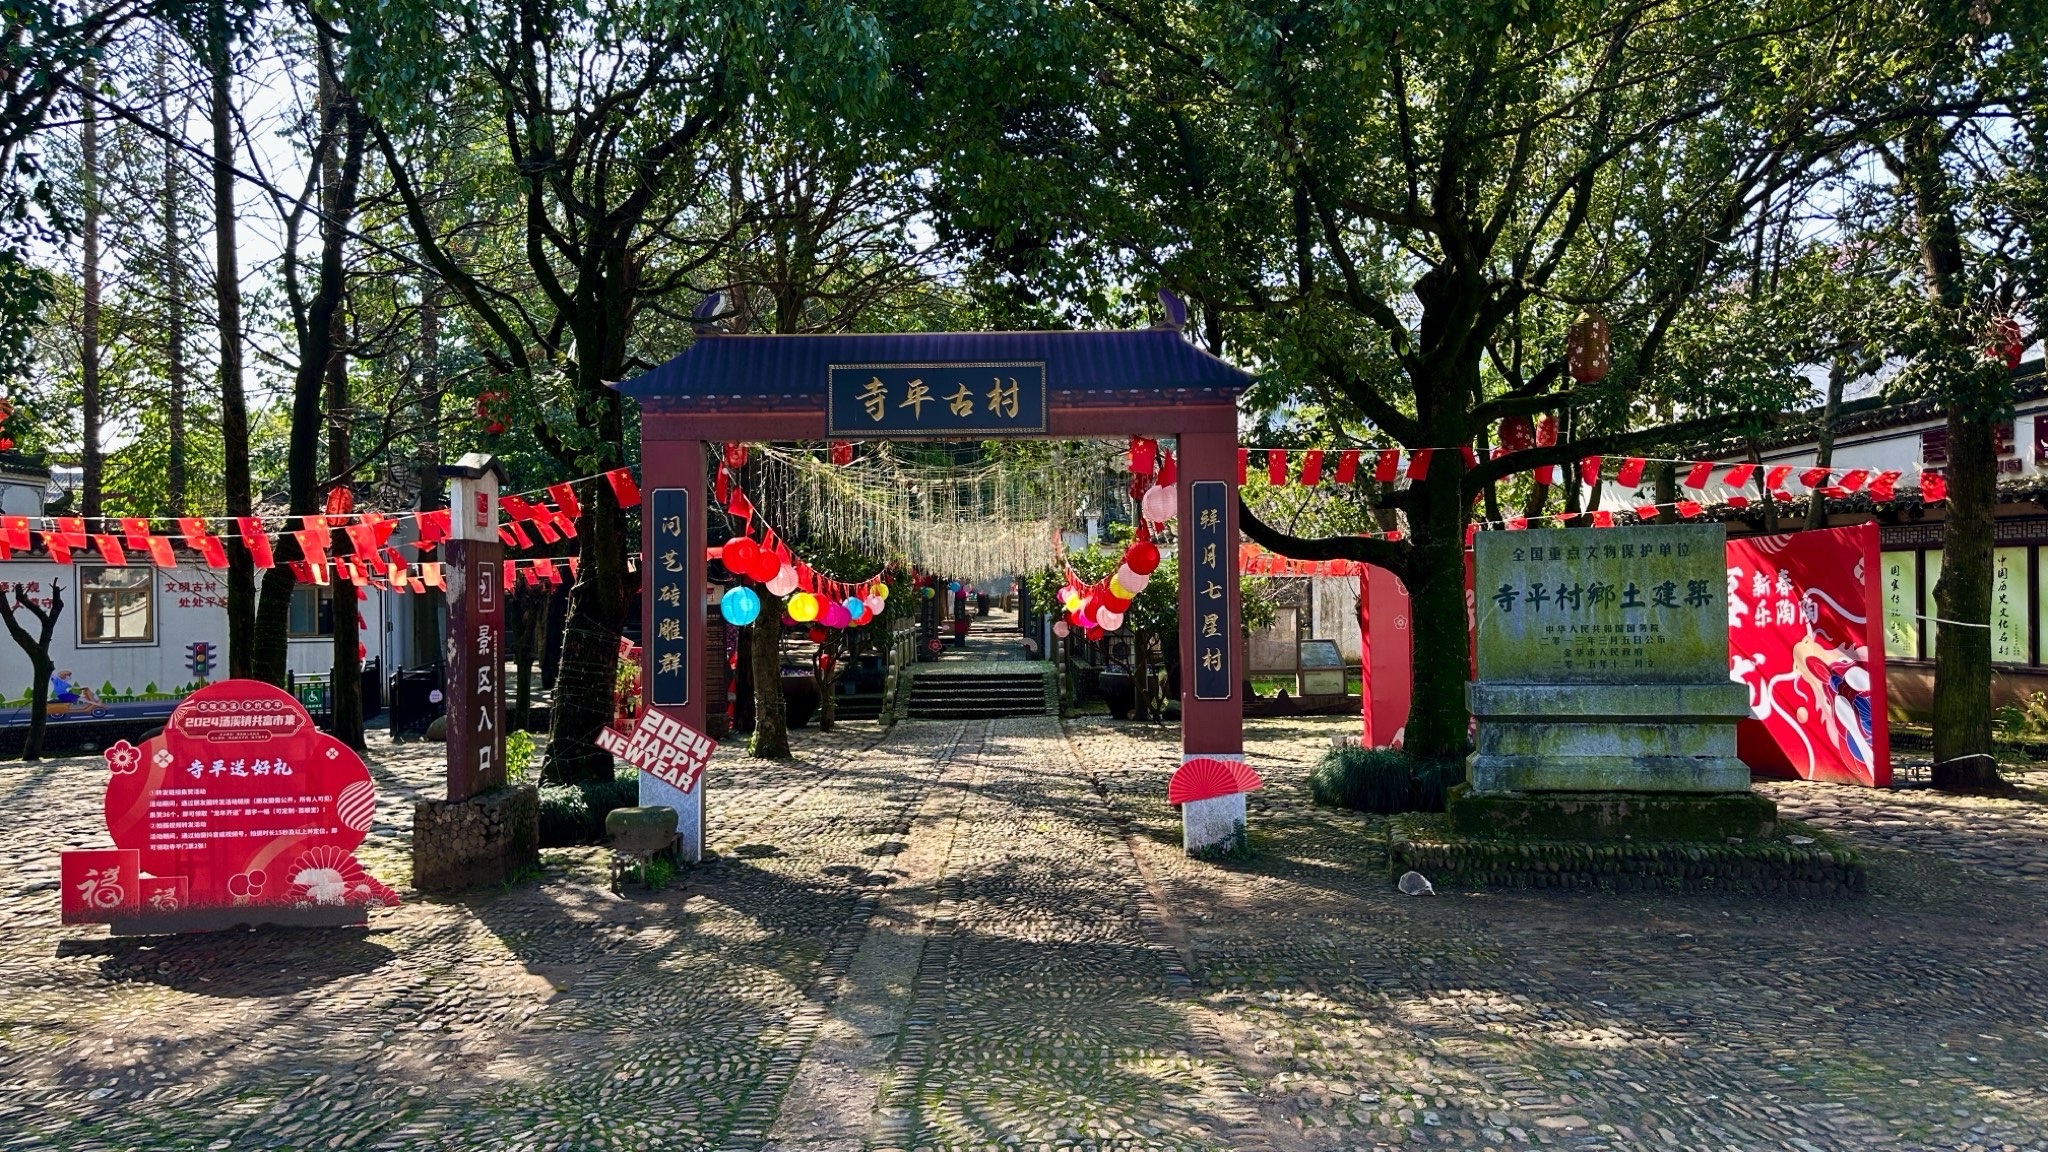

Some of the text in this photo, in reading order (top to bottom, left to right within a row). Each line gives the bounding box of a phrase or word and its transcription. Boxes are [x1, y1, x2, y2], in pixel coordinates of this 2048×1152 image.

[854, 375, 1020, 423] 寺平古村
[1511, 542, 1691, 562] 全国重点文物保护单位
[165, 581, 217, 592] 文明古村
[657, 515, 685, 677] 问艺砖雕群
[1491, 578, 1714, 613] 寺平村鄉土建築
[1751, 568, 1794, 597] 新春
[1754, 598, 1819, 627] 乐陶陶
[1997, 554, 2010, 656] 中国历史文化名村
[1539, 634, 1667, 646] 二零一三年三月五日公布
[1545, 623, 1660, 634] 中华人民共和国国务院
[1551, 659, 1655, 670] 二零一五年十二月立
[1563, 647, 1644, 658] 金华市人民政府
[477, 624, 494, 772] 景区入口
[640, 708, 712, 761] 2024
[631, 728, 703, 776] HAPPY
[186, 758, 294, 778] 寺平送好礼
[76, 865, 125, 908] 福
